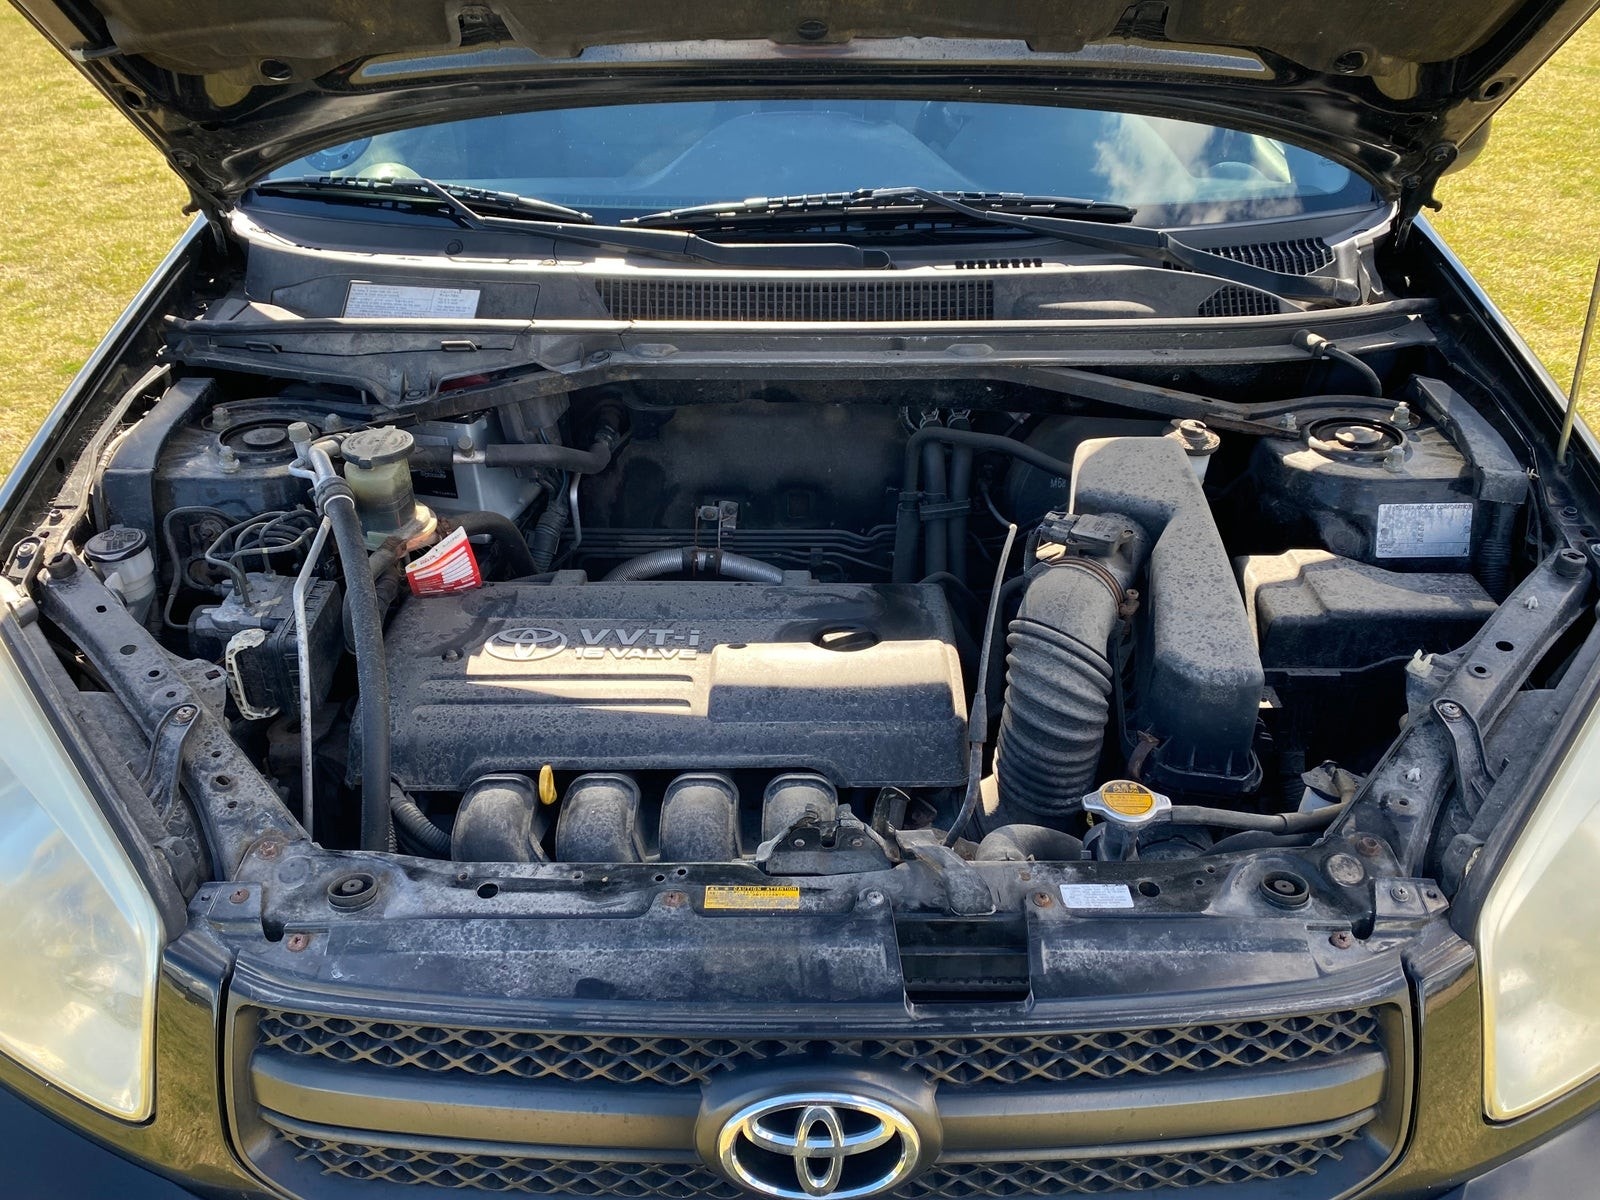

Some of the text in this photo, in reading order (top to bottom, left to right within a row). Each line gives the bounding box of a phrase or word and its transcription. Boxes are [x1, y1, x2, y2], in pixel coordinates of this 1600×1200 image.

[580, 628, 700, 647] VVT-i
[575, 647, 698, 660] 16 VALVE
